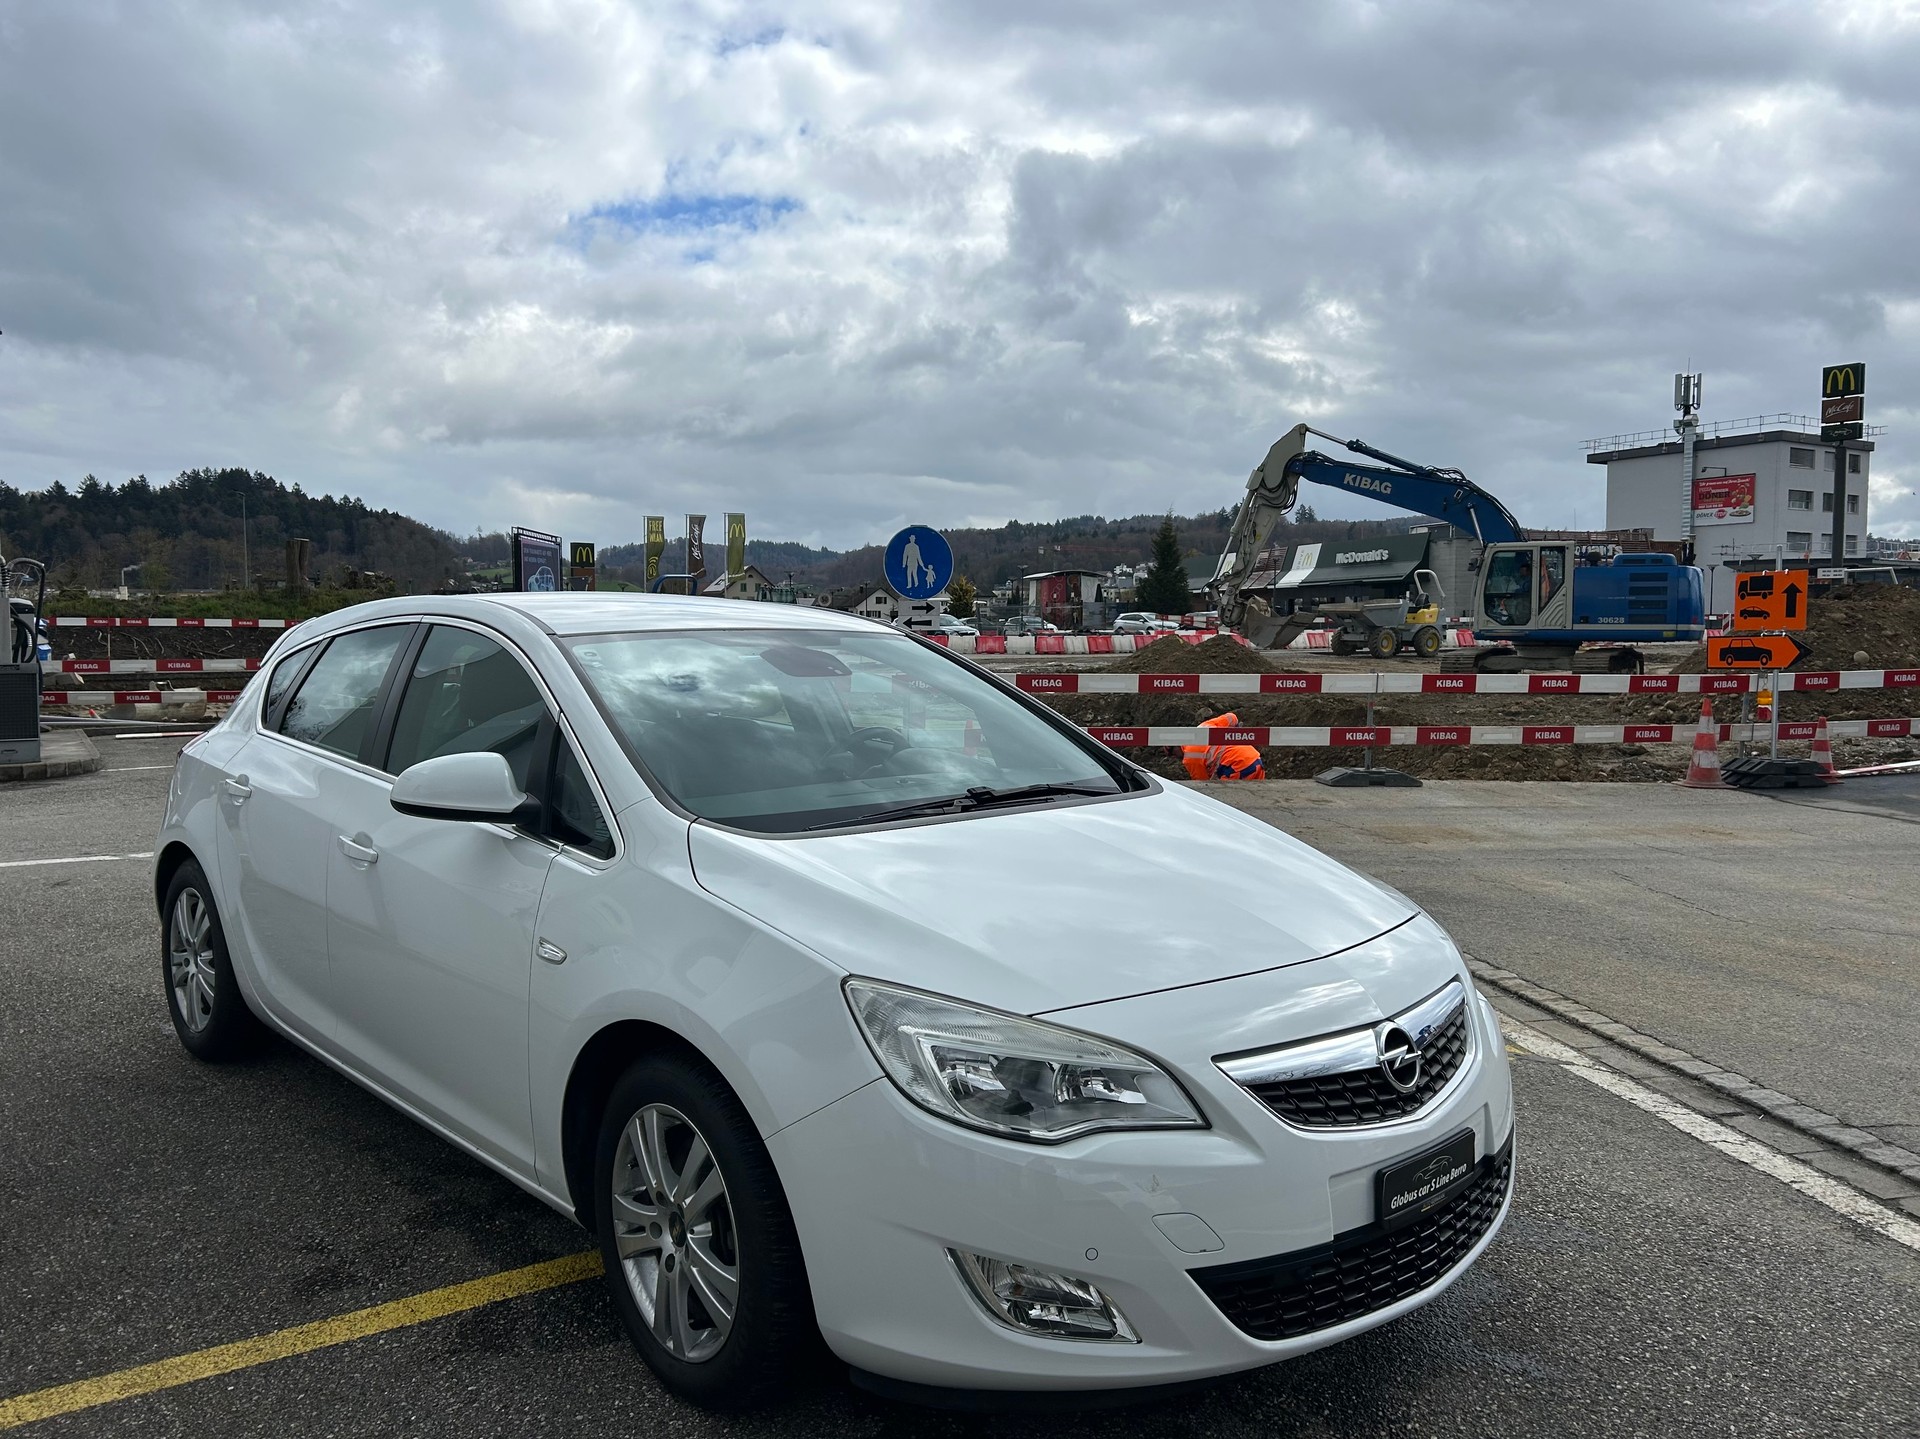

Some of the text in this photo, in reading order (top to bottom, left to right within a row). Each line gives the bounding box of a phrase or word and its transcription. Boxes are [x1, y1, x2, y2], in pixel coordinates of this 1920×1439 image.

[1343, 472, 1392, 494] KIBAG
[648, 520, 662, 532] FREE
[1335, 549, 1389, 564] McDonald's
[1597, 616, 1625, 624] 30628
[1805, 677, 1829, 685] KIBAG
[1894, 674, 1917, 682] KIBAG
[1275, 680, 1307, 688] KIBAG
[1436, 680, 1464, 688] KIBAG
[1713, 680, 1738, 688] KIBAG
[1789, 727, 1813, 735] KIBAG
[1878, 724, 1901, 732] KIBAG
[1103, 733, 1134, 741] KIBAG
[1224, 733, 1256, 741] KIBAG
[1430, 732, 1458, 740] KIBAG
[1535, 731, 1561, 739] KIBAG
[1635, 730, 1661, 738] KIBAG
[1391, 1189, 1417, 1209] Globus
[1418, 1183, 1431, 1197] car
[1430, 1178, 1436, 1191] S
[1436, 1173, 1450, 1189] Line
[1450, 1163, 1467, 1181] Berro
